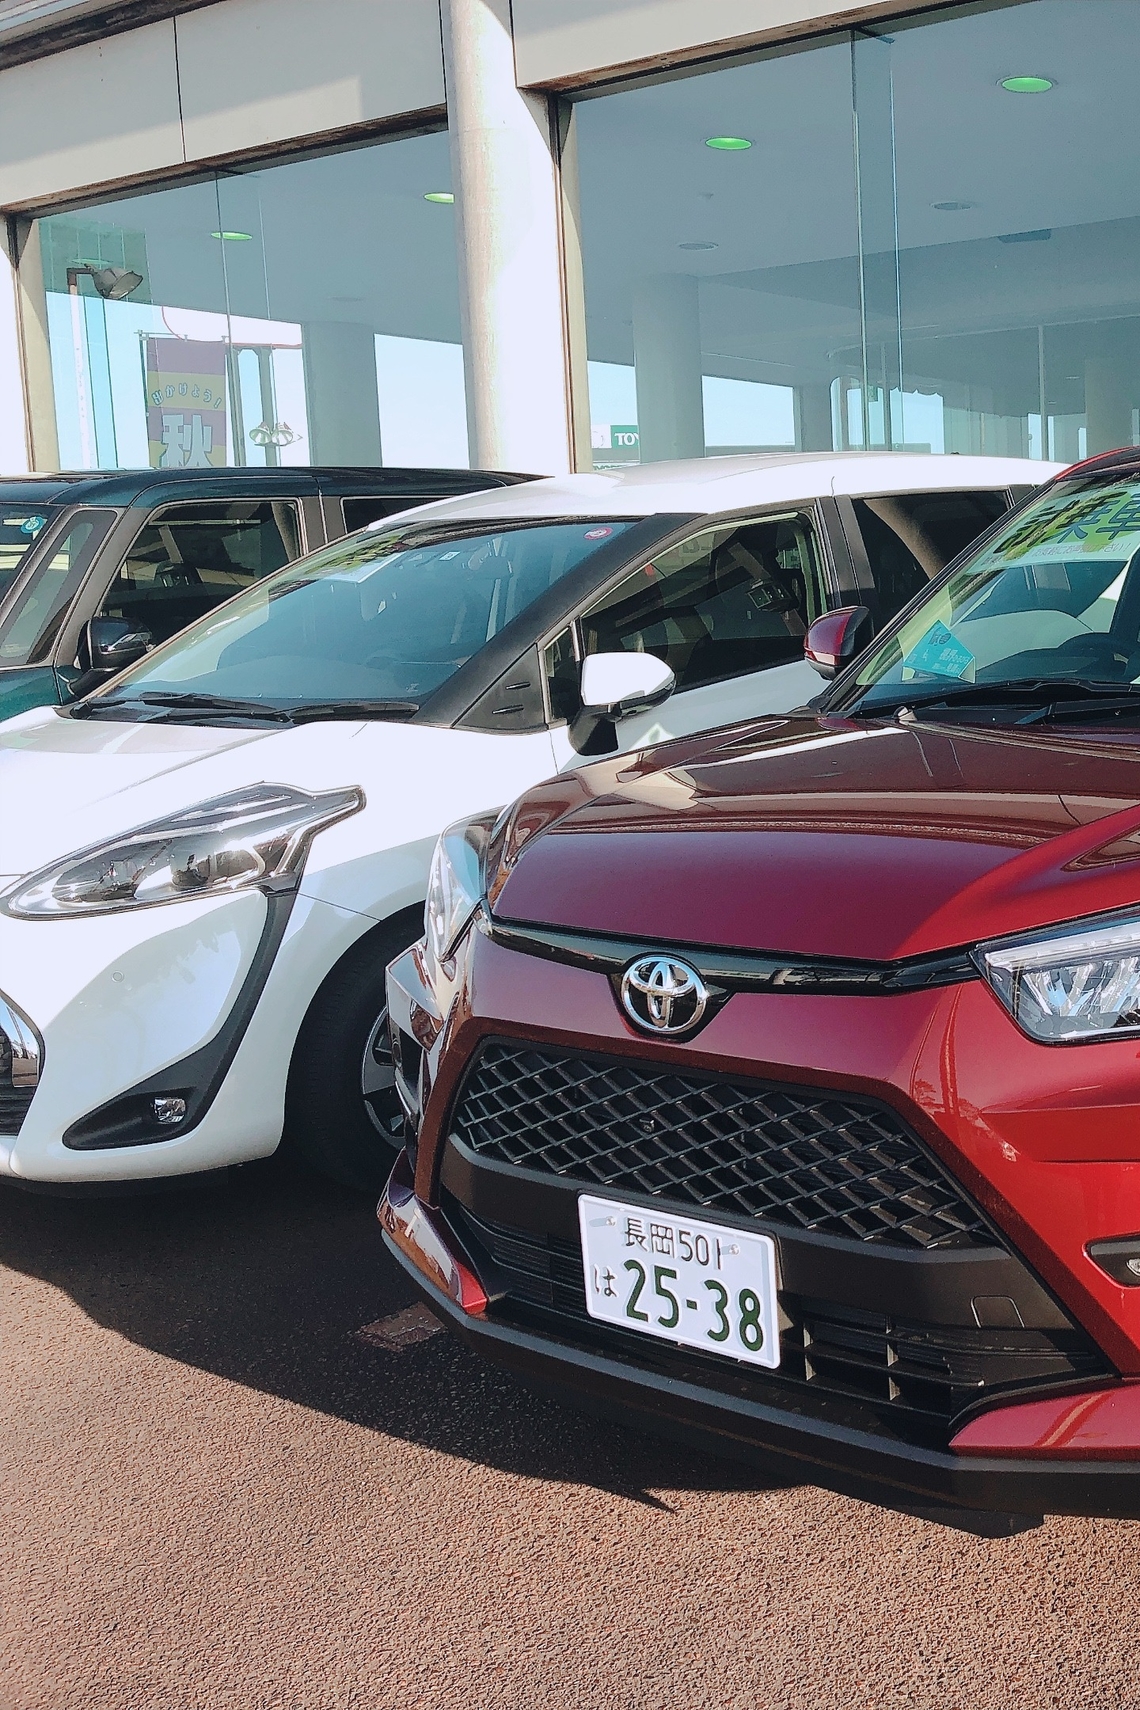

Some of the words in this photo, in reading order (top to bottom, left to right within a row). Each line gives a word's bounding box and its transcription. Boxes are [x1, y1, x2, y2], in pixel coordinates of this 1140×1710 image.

[160, 413, 214, 467] 秋
[594, 1265, 617, 1298] は
[623, 1259, 764, 1352] 25-38
